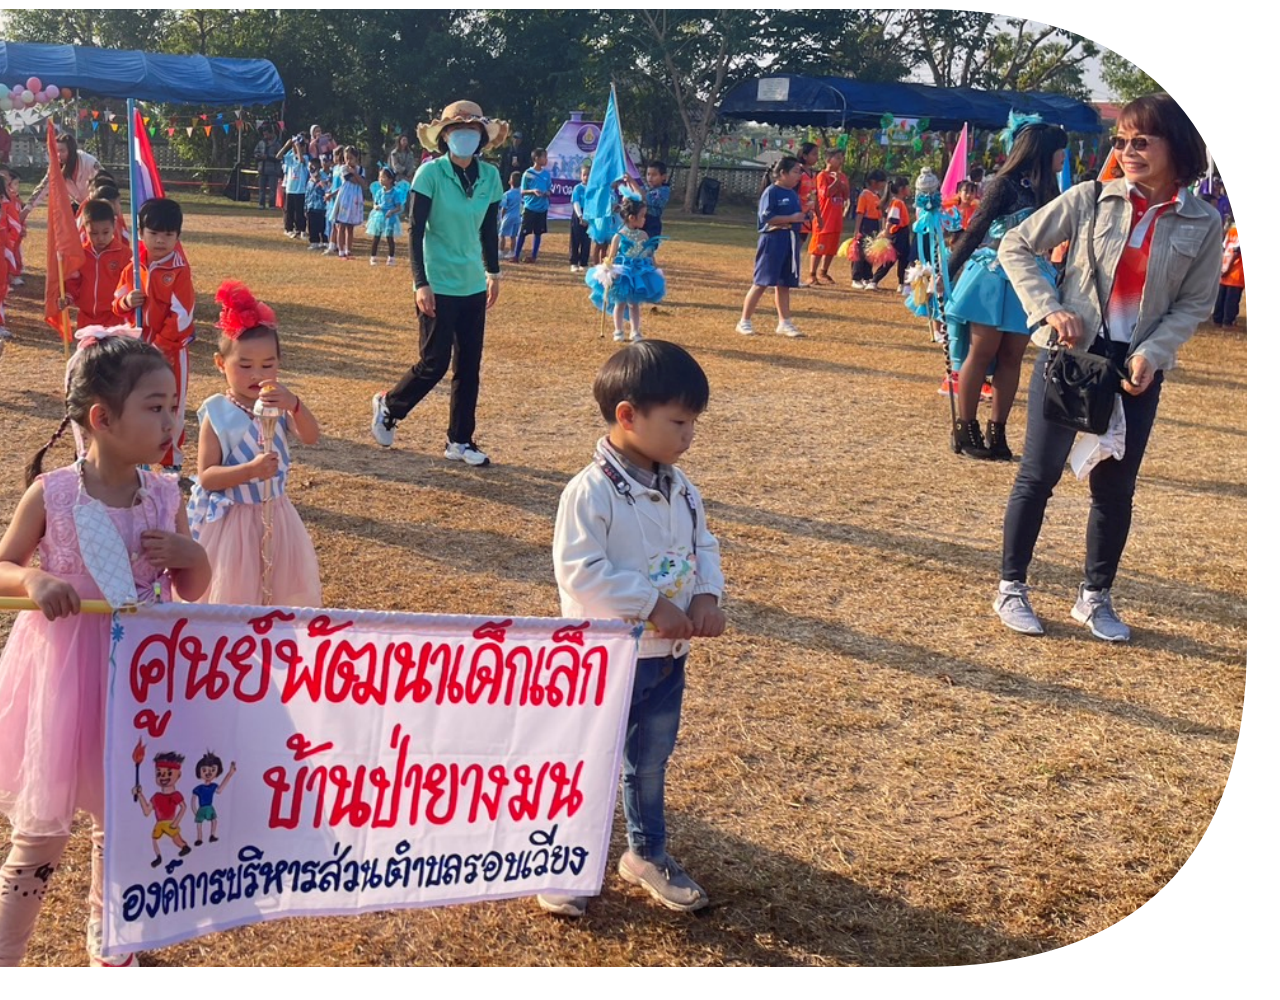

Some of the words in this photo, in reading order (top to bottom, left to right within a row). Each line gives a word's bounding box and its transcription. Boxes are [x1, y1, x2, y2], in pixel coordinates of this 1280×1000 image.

[130, 610, 608, 738] ศูนย์พัฒนาเด็กเล็ก
[263, 724, 584, 829] บ้านป่ายางมน
